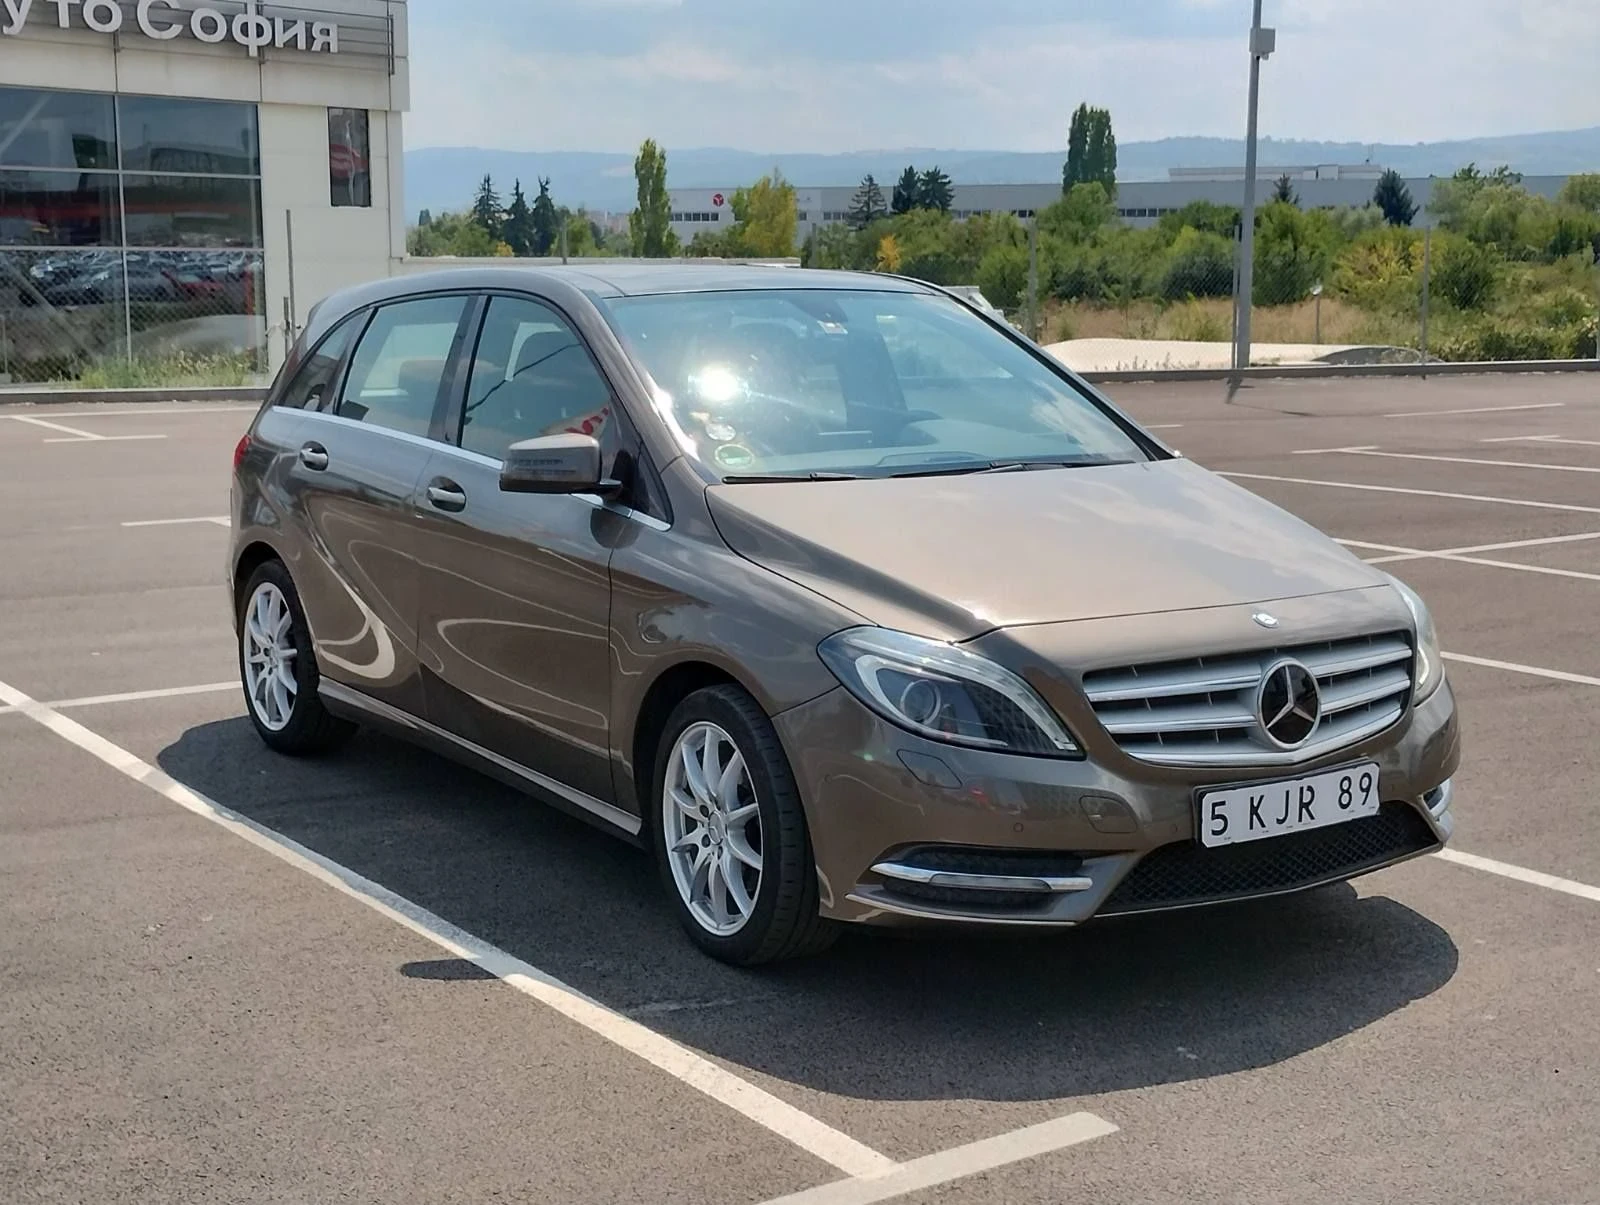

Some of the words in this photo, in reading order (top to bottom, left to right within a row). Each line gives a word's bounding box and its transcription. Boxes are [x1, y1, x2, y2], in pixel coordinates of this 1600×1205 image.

[137, 0, 338, 57] София
[1210, 800, 1228, 836] 5
[1249, 786, 1316, 830] KJR
[1338, 772, 1372, 810] 89
